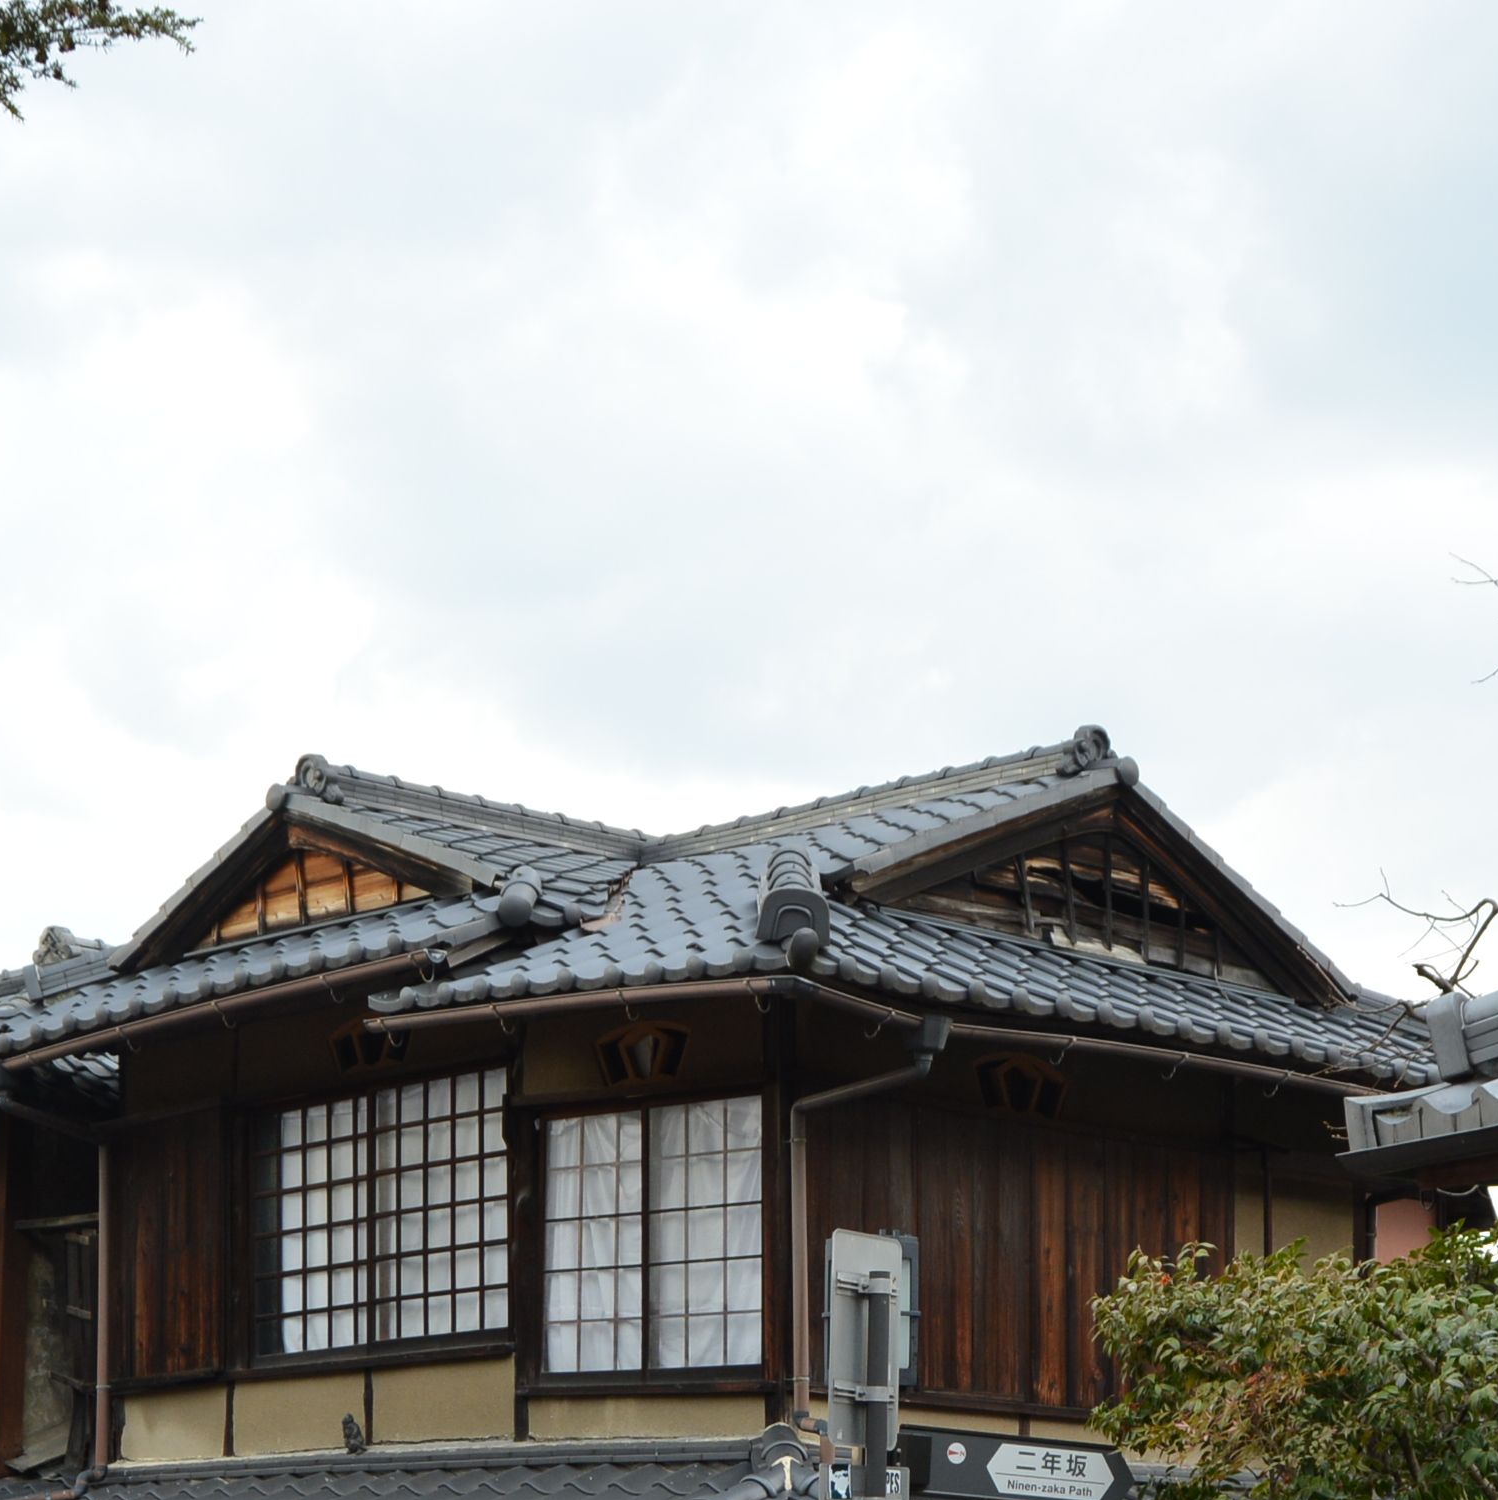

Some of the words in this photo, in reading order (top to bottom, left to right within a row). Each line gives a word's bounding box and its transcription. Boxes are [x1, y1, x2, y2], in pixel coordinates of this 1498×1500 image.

[1016, 1451, 1088, 1478] 二年坂
[1007, 1480, 1066, 1495] Ninen-zaka
[1068, 1485, 1093, 1497] Path
